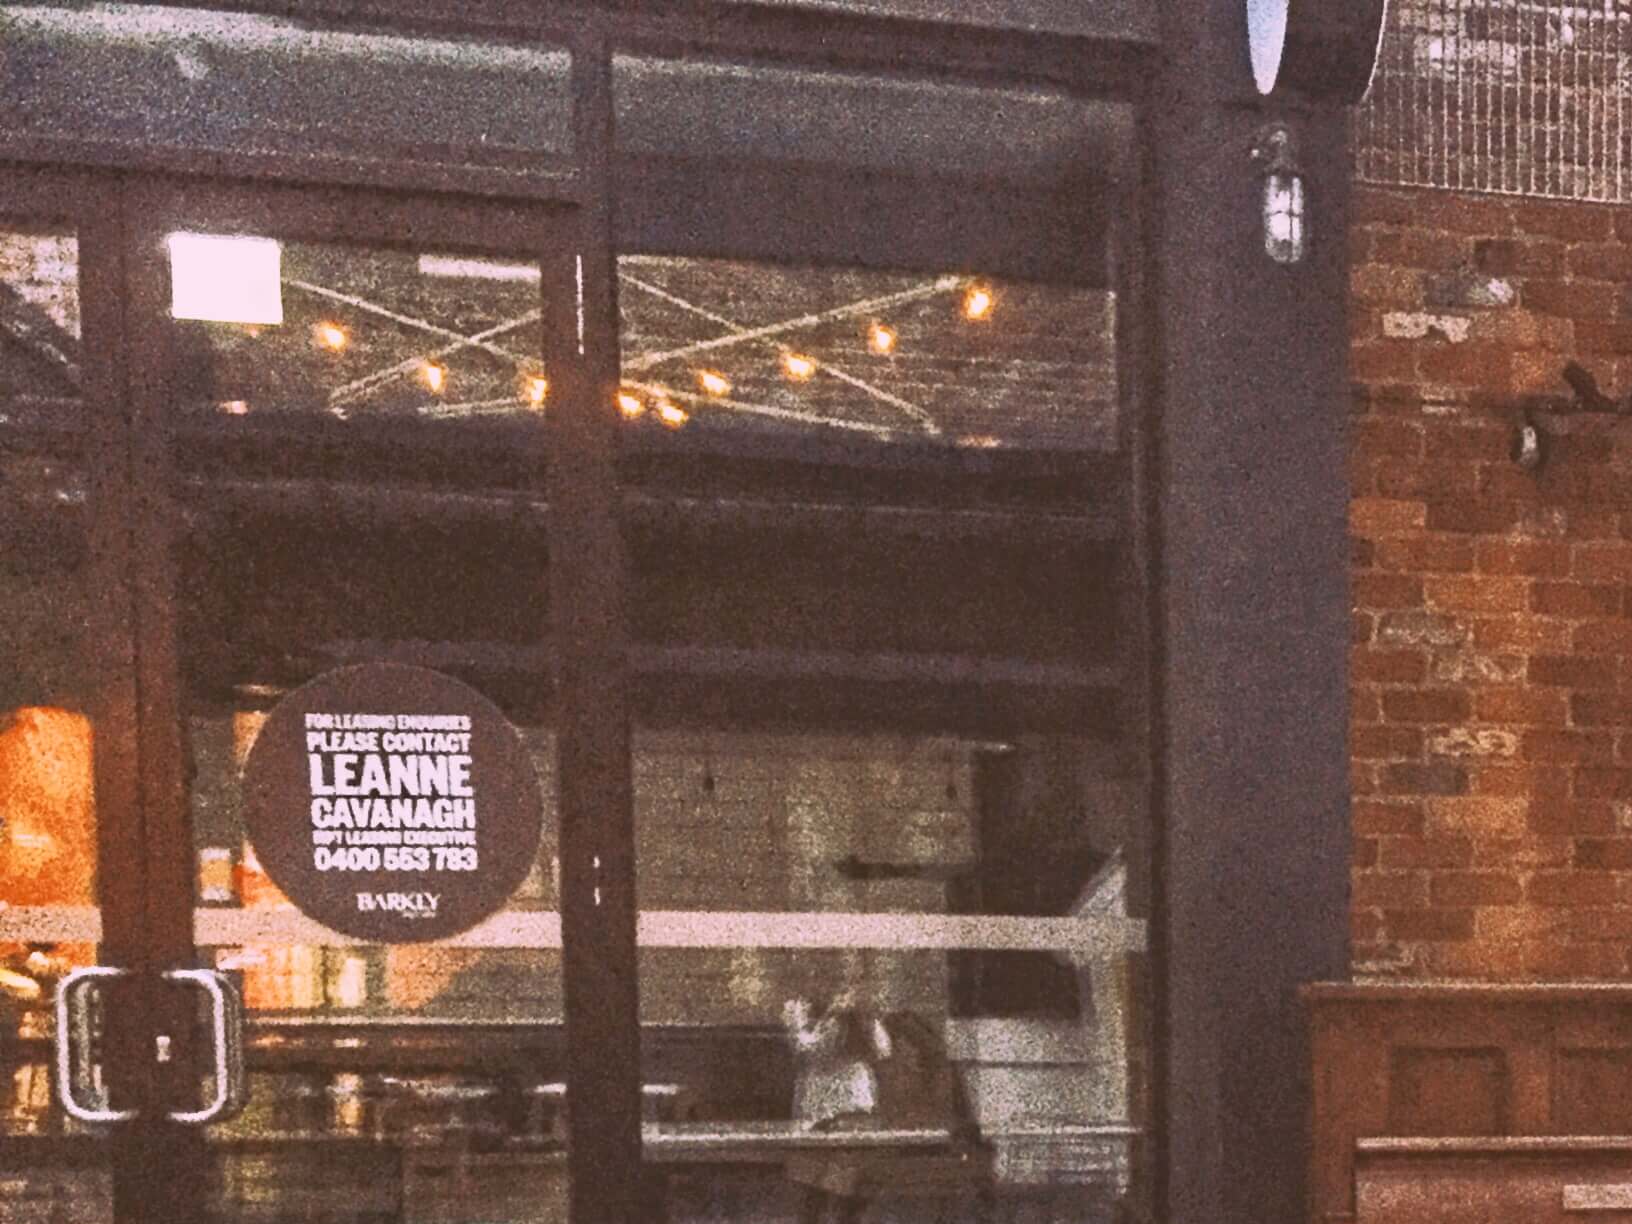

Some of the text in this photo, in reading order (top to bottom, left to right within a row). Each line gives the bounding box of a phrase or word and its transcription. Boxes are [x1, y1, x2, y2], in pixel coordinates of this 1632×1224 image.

[306, 731, 472, 753] PLEASE CONTACT
[308, 753, 474, 797] LEANNE
[311, 798, 477, 829] CAVANAGH
[314, 846, 381, 872] 0400
[432, 846, 478, 872] 783
[355, 891, 441, 912] BARKLY
